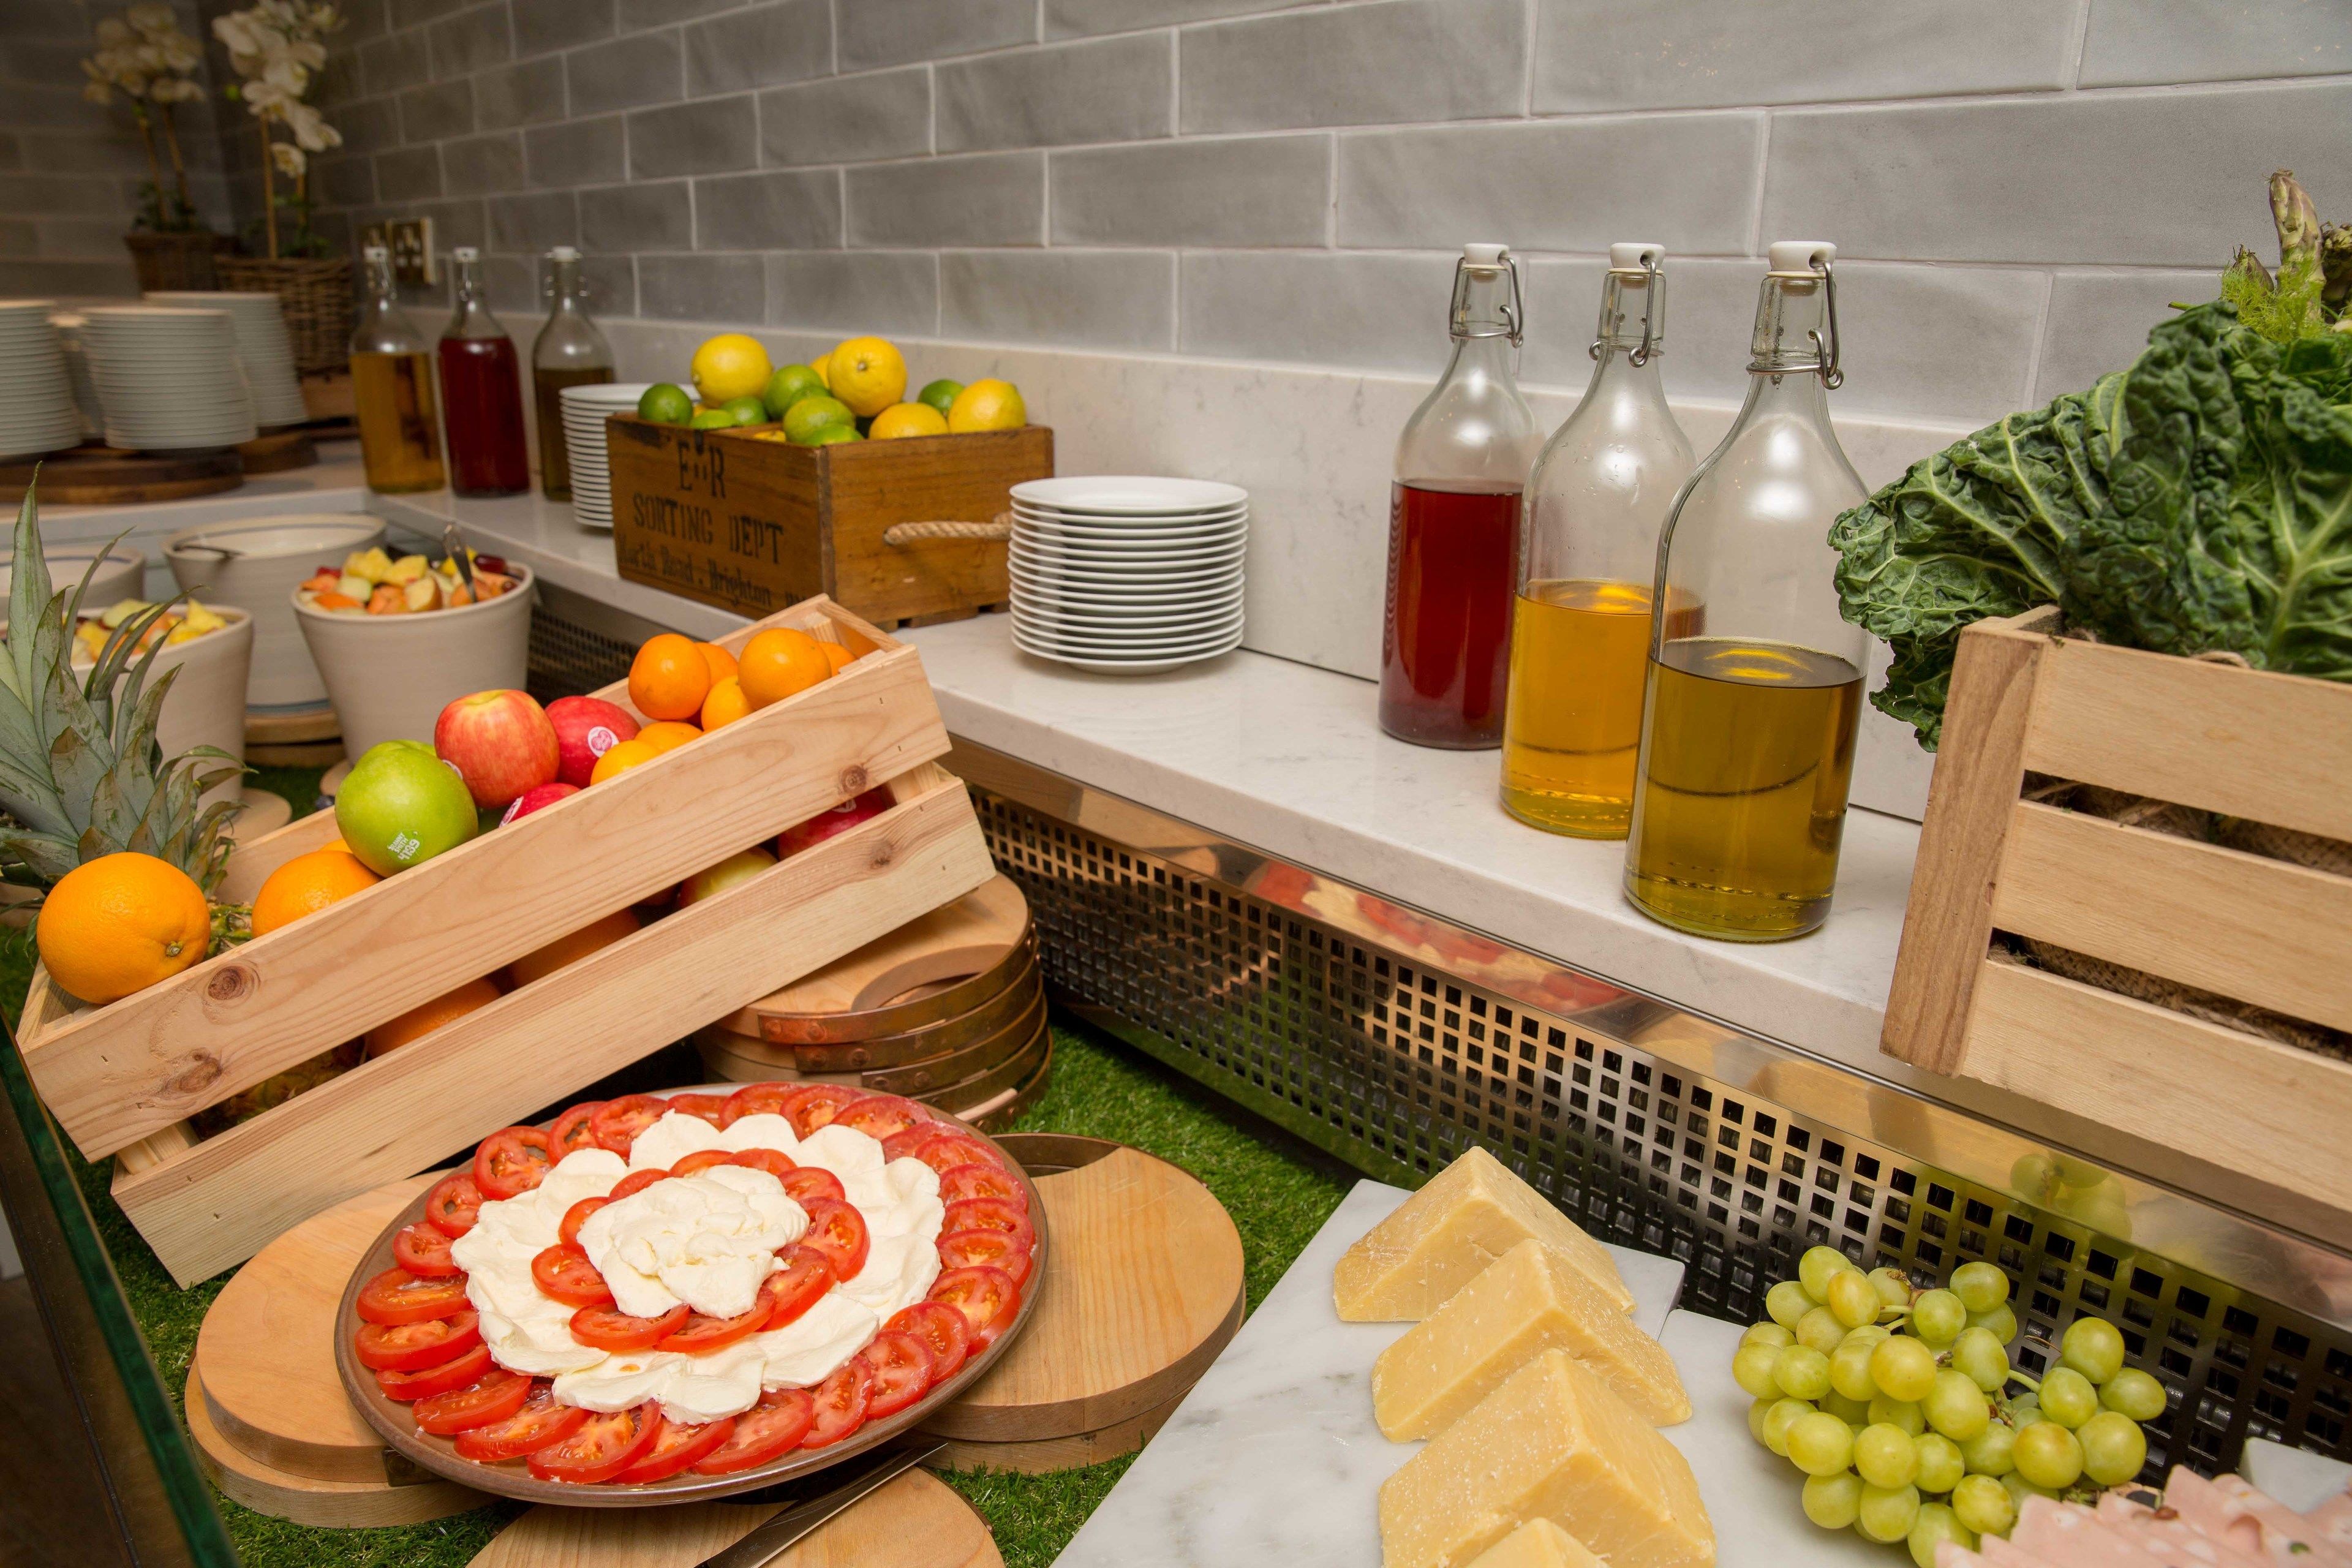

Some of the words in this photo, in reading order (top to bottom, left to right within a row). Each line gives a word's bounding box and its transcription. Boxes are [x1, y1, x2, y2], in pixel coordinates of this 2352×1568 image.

[633, 492, 713, 545] SORTING
[729, 515, 784, 564] DEPT
[398, 839, 420, 860] 4139
